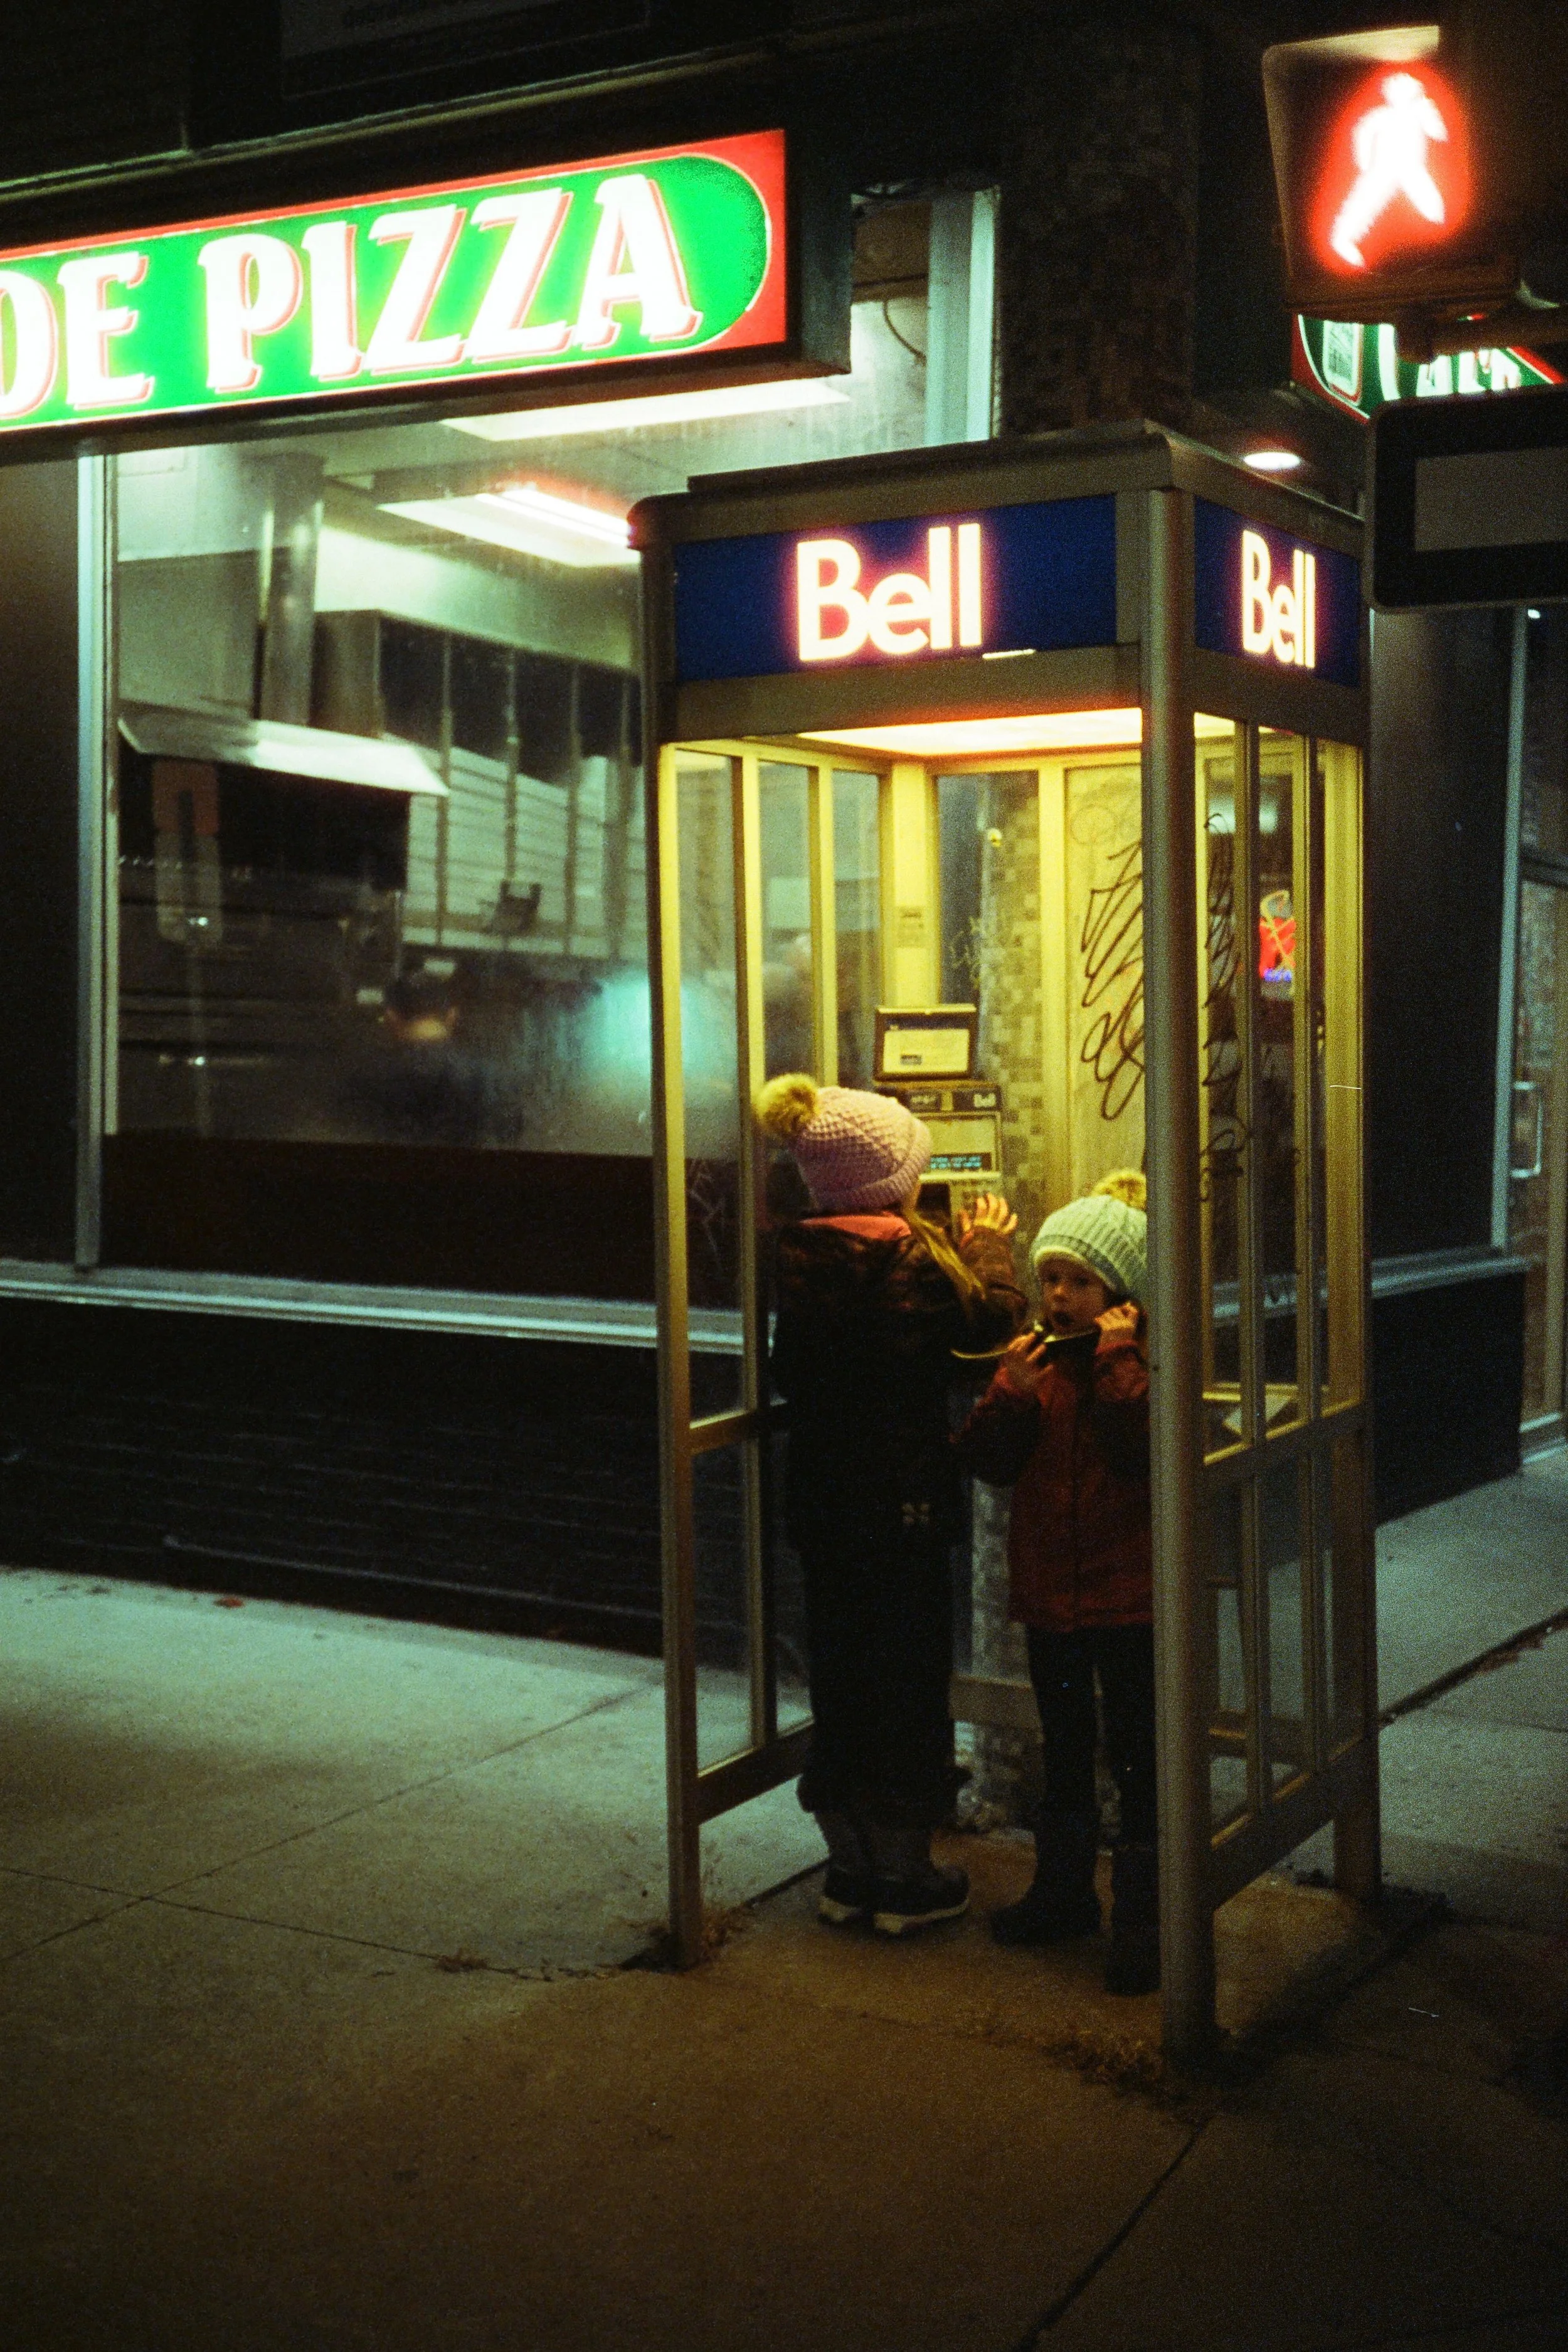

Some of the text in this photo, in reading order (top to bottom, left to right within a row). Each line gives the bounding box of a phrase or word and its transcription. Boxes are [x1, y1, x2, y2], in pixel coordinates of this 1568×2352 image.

[198, 174, 703, 394] PIZZA
[797, 523, 983, 662] Bell
[1242, 530, 1315, 669] Bell
